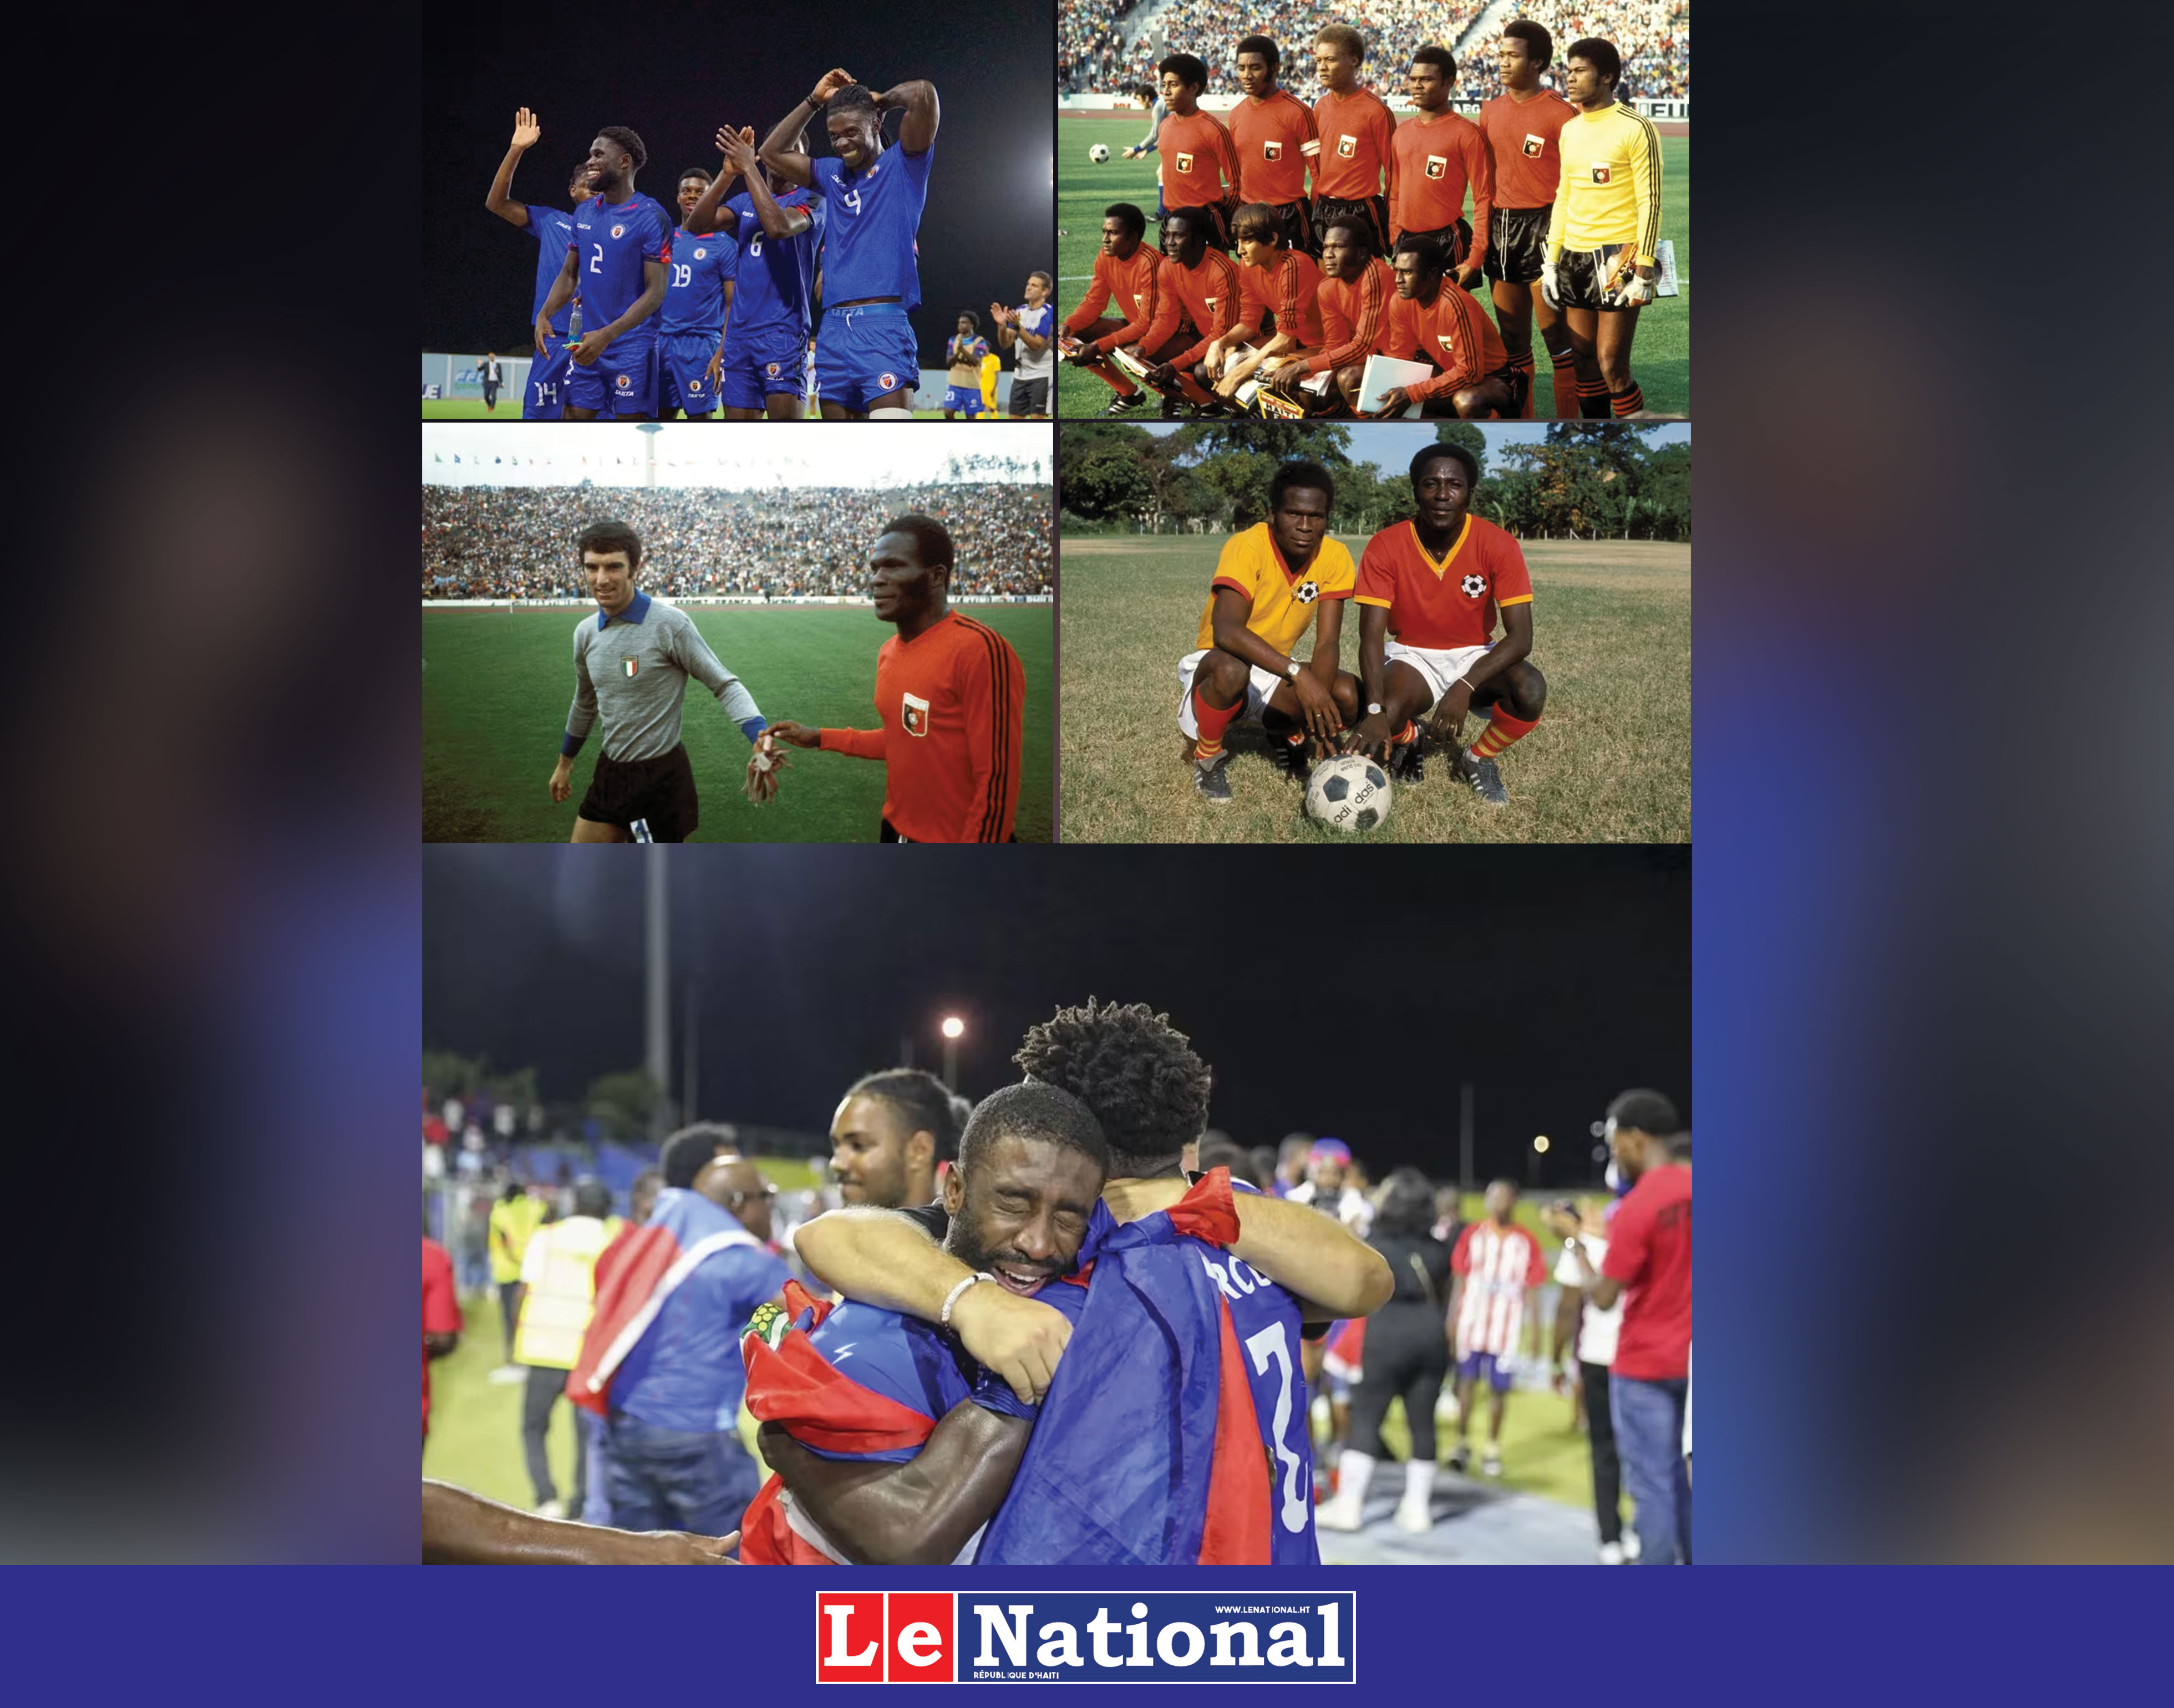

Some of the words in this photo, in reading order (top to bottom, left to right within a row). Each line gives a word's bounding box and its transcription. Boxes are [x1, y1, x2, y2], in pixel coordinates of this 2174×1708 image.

[1453, 104, 1480, 113] AEG
[844, 189, 861, 216] 4
[750, 231, 764, 257] 6
[590, 243, 603, 273] 2
[671, 263, 692, 287] 19
[831, 307, 864, 317] SAETA
[534, 382, 557, 406] 14
[1266, 403, 1296, 419] HAITI
[1334, 805, 1352, 823] adi
[1246, 1320, 1308, 1533] 7
